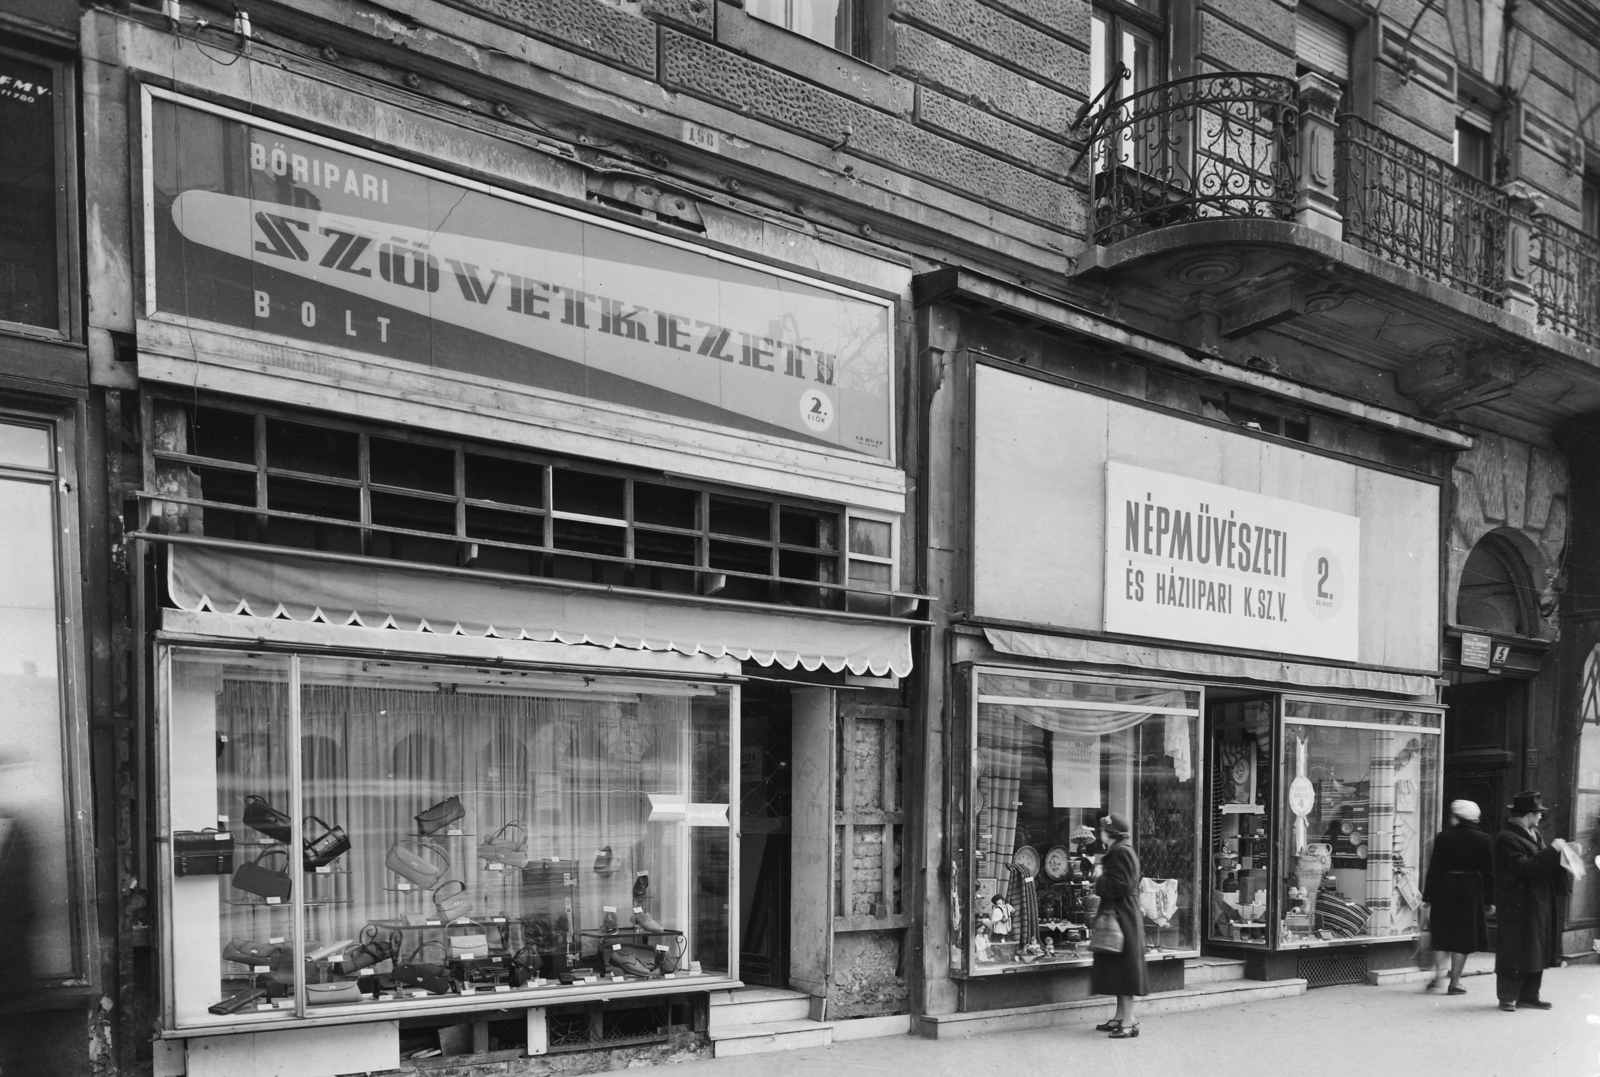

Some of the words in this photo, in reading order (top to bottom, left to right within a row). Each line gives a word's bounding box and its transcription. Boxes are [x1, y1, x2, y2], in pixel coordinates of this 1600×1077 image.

[250, 142, 388, 204] BŐRIPARI
[254, 290, 391, 343] BOLT
[807, 414, 826, 423] FIÓK
[810, 397, 828, 415] 2.
[1125, 559, 1145, 602] ÉS
[1156, 566, 1232, 615] HÁZIIPARI
[1317, 556, 1333, 600] 2.
